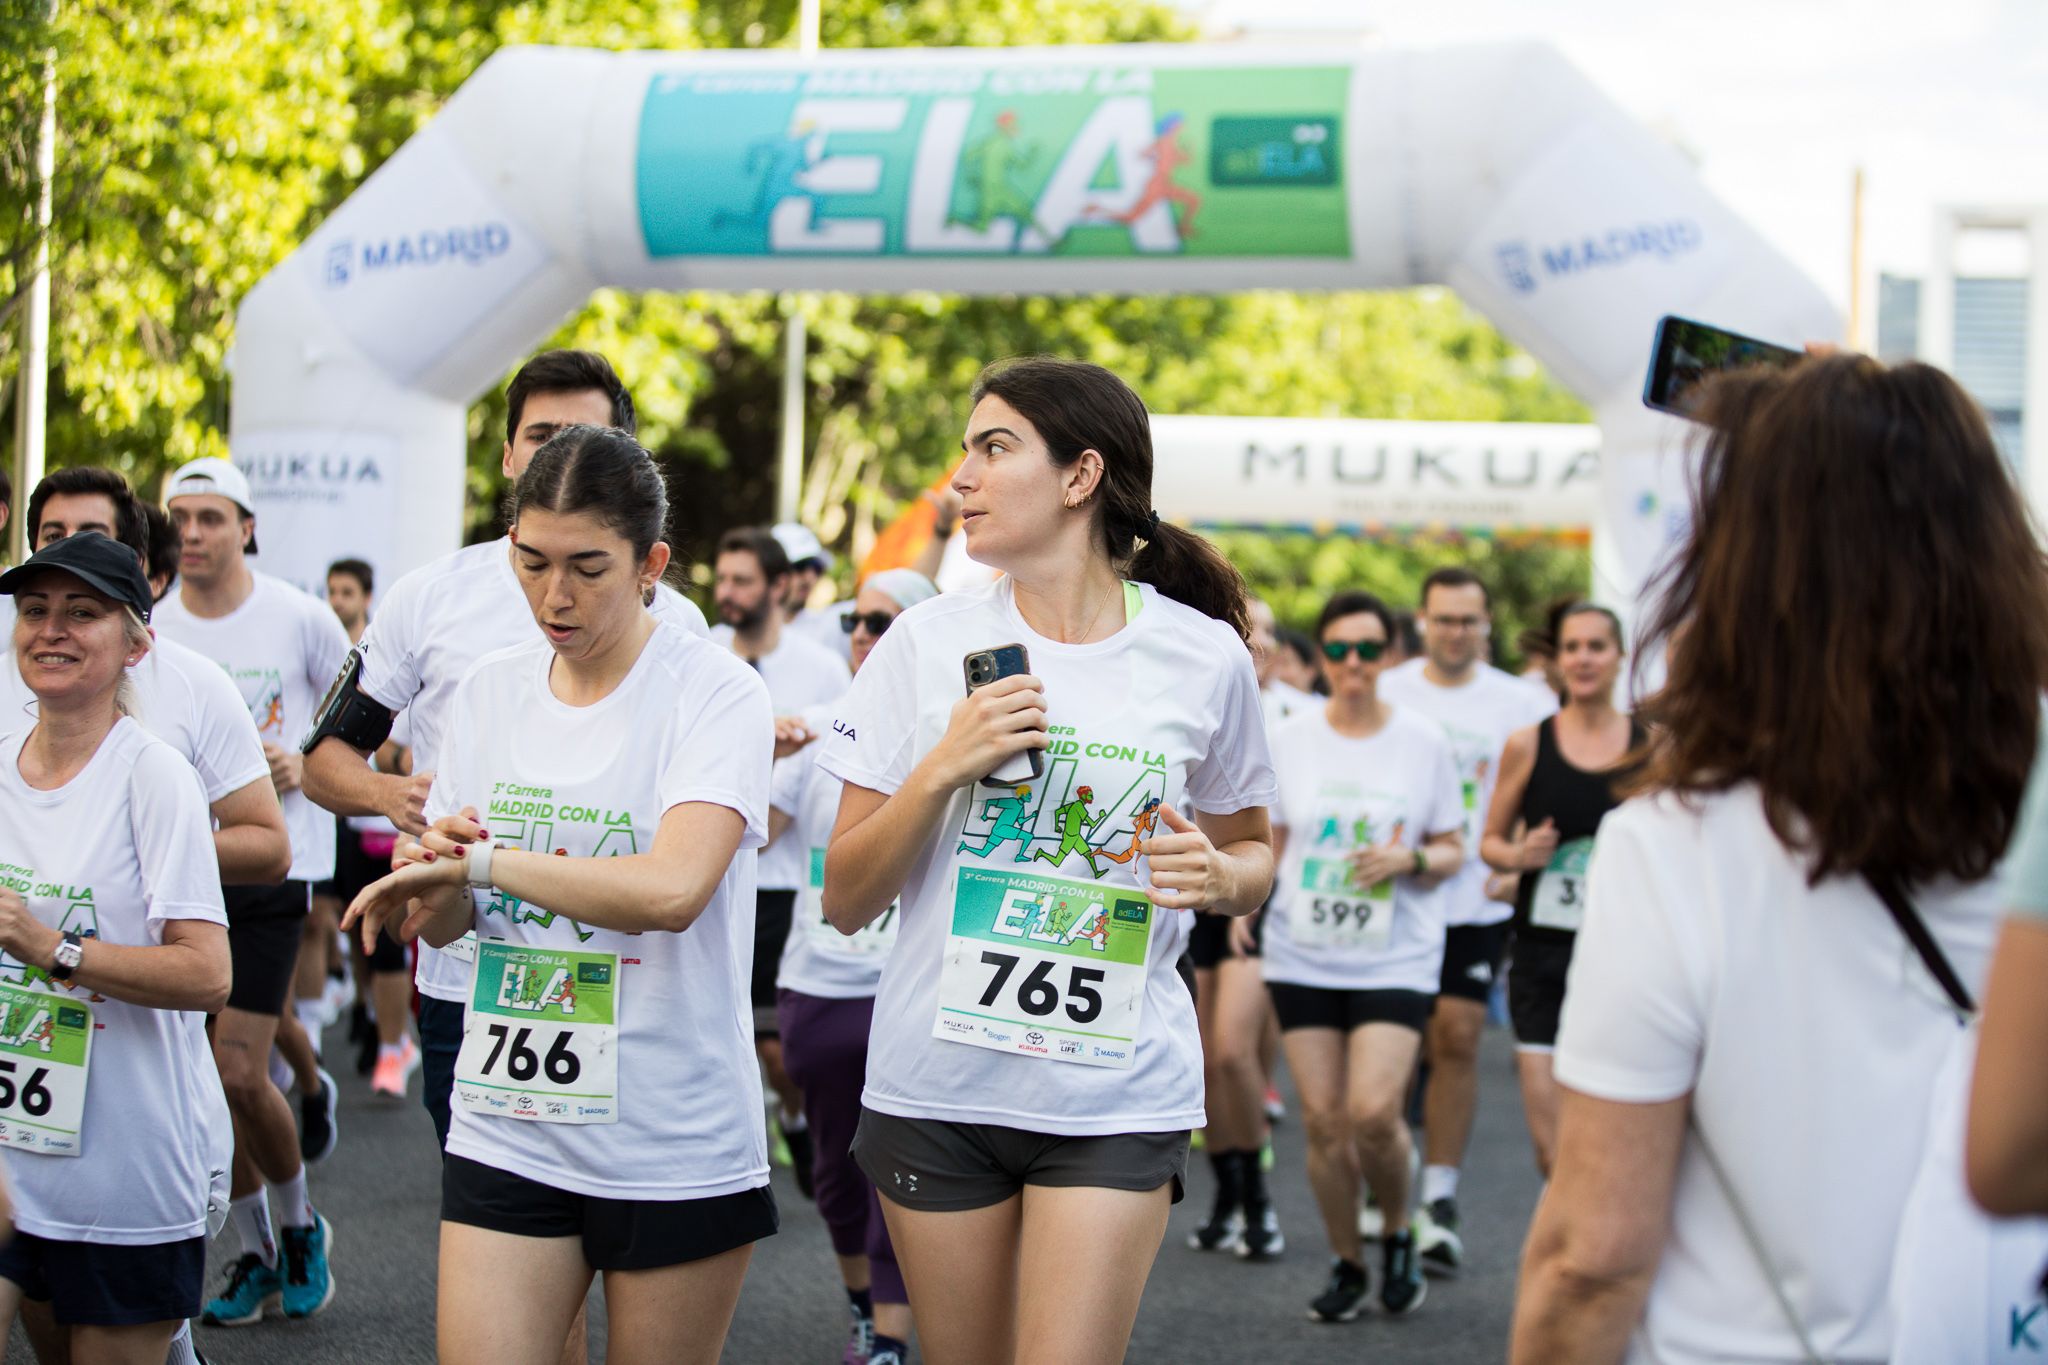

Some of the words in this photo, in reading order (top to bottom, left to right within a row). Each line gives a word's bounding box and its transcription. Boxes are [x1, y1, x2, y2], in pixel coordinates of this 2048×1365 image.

[767, 96, 1183, 253] ELA
[363, 223, 510, 267] MADRID
[1541, 218, 1702, 276] MADRID
[1085, 743, 1137, 761] CON
[1142, 751, 1166, 768] LA
[507, 784, 553, 798] Carrera
[488, 800, 554, 818] MADRID
[558, 805, 600, 823] CON
[604, 810, 632, 826] LA
[35, 882, 63, 897] CON
[67, 886, 93, 901] LA
[975, 874, 1005, 883] Carrera
[1007, 877, 1056, 893] MADRID
[1059, 886, 1087, 898] CON
[1089, 890, 1104, 901] LA
[991, 889, 1106, 951] ELA
[1312, 899, 1372, 930] 599
[529, 954, 553, 965] CON
[554, 956, 569, 966] LA
[496, 963, 576, 1014] ELA
[978, 950, 1105, 1024] 765
[944, 1020, 974, 1031] MUKUA
[988, 1031, 1011, 1042] Biogen
[480, 1023, 581, 1085] 766
[1059, 1039, 1079, 1047] SPORT
[1061, 1046, 1076, 1054] LIFE
[1101, 1050, 1125, 1059] MADRID
